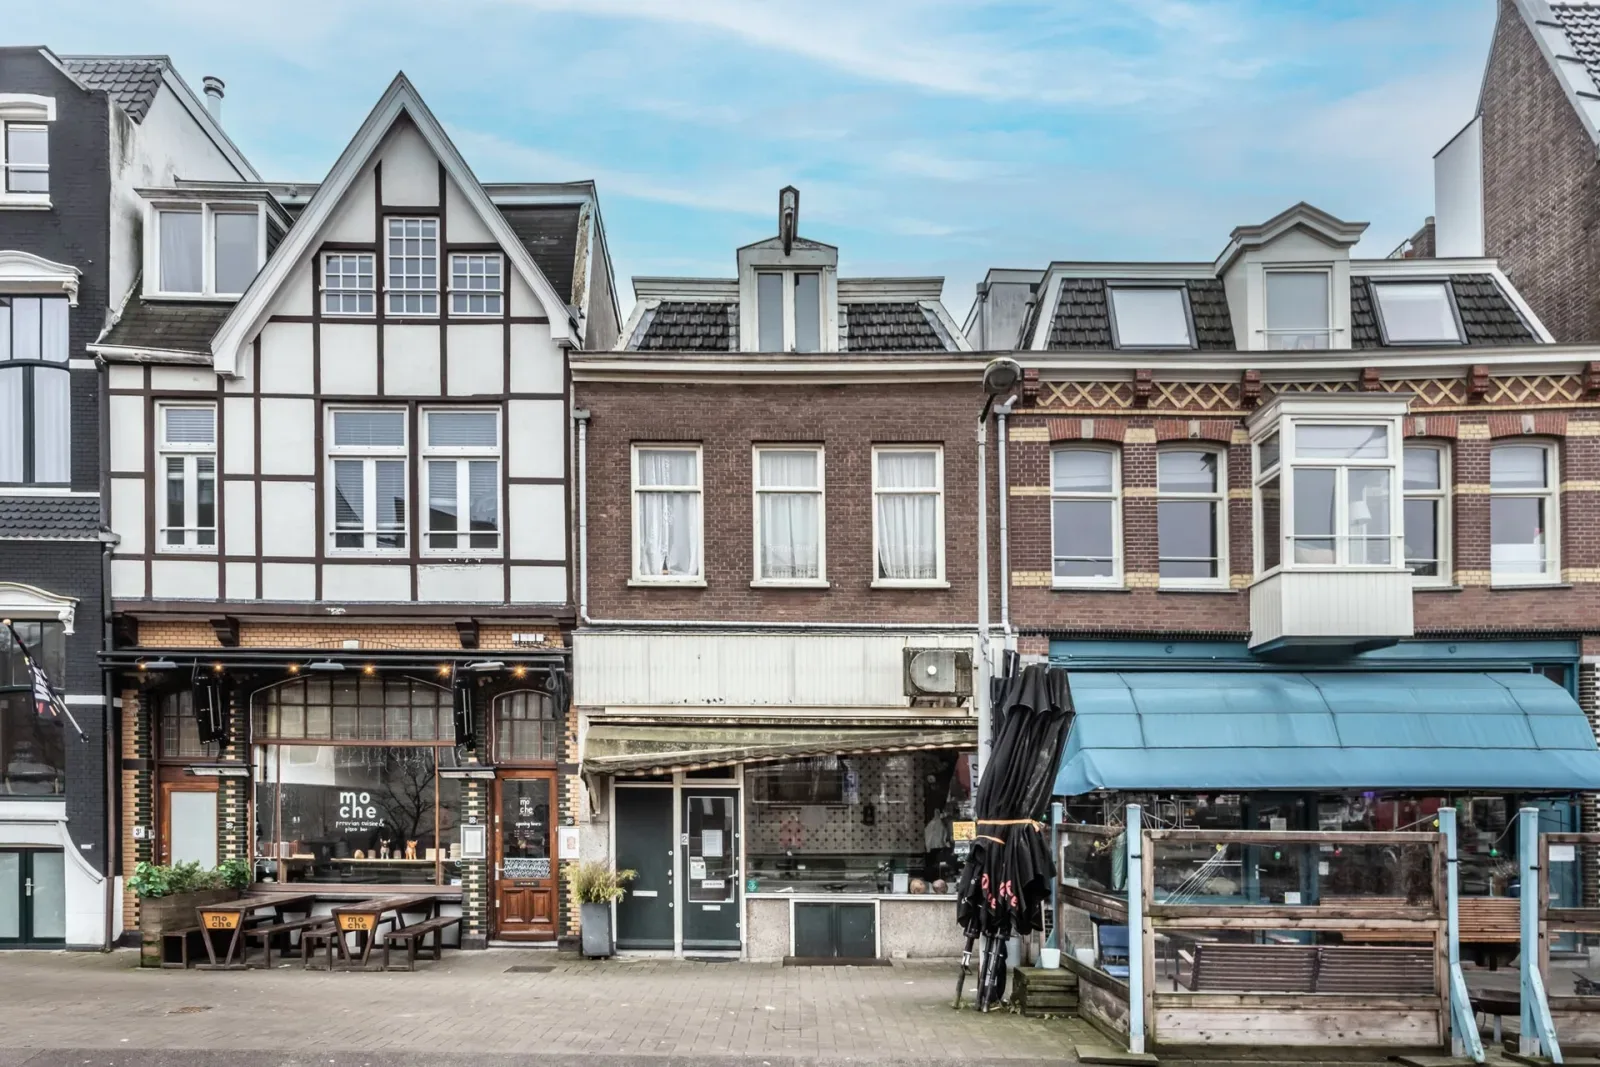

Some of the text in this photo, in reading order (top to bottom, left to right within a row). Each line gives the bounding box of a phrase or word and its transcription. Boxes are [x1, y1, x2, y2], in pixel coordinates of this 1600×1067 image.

[339, 791, 371, 804] mo
[339, 804, 377, 819] che
[519, 806, 533, 814] che
[682, 835, 687, 843] 2
